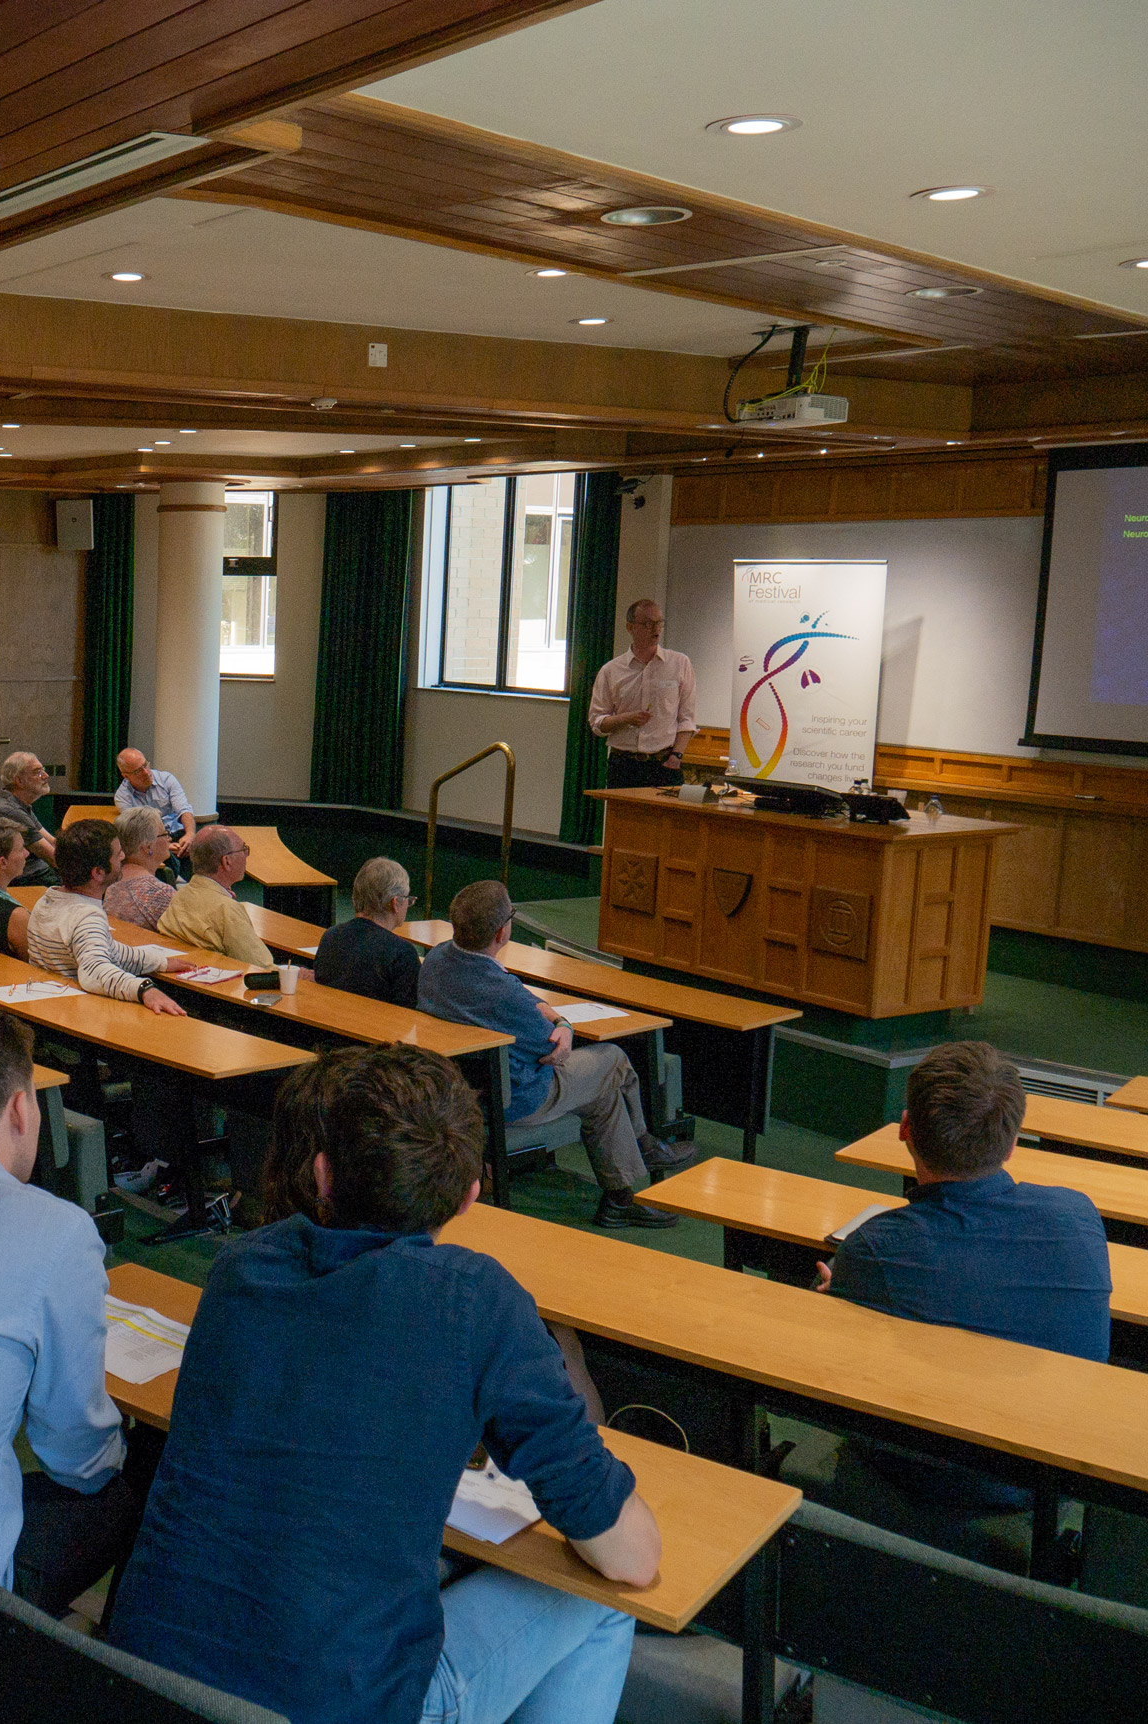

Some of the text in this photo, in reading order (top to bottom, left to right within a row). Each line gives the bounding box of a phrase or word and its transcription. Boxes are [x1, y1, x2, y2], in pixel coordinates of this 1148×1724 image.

[749, 572, 782, 584] MRC
[748, 585, 801, 599] Festival
[811, 714, 867, 727] Inspiring your
[802, 726, 837, 736] scientific
[793, 748, 865, 760] Discover how the
[790, 759, 865, 771] research you fund
[807, 772, 842, 783] changes
